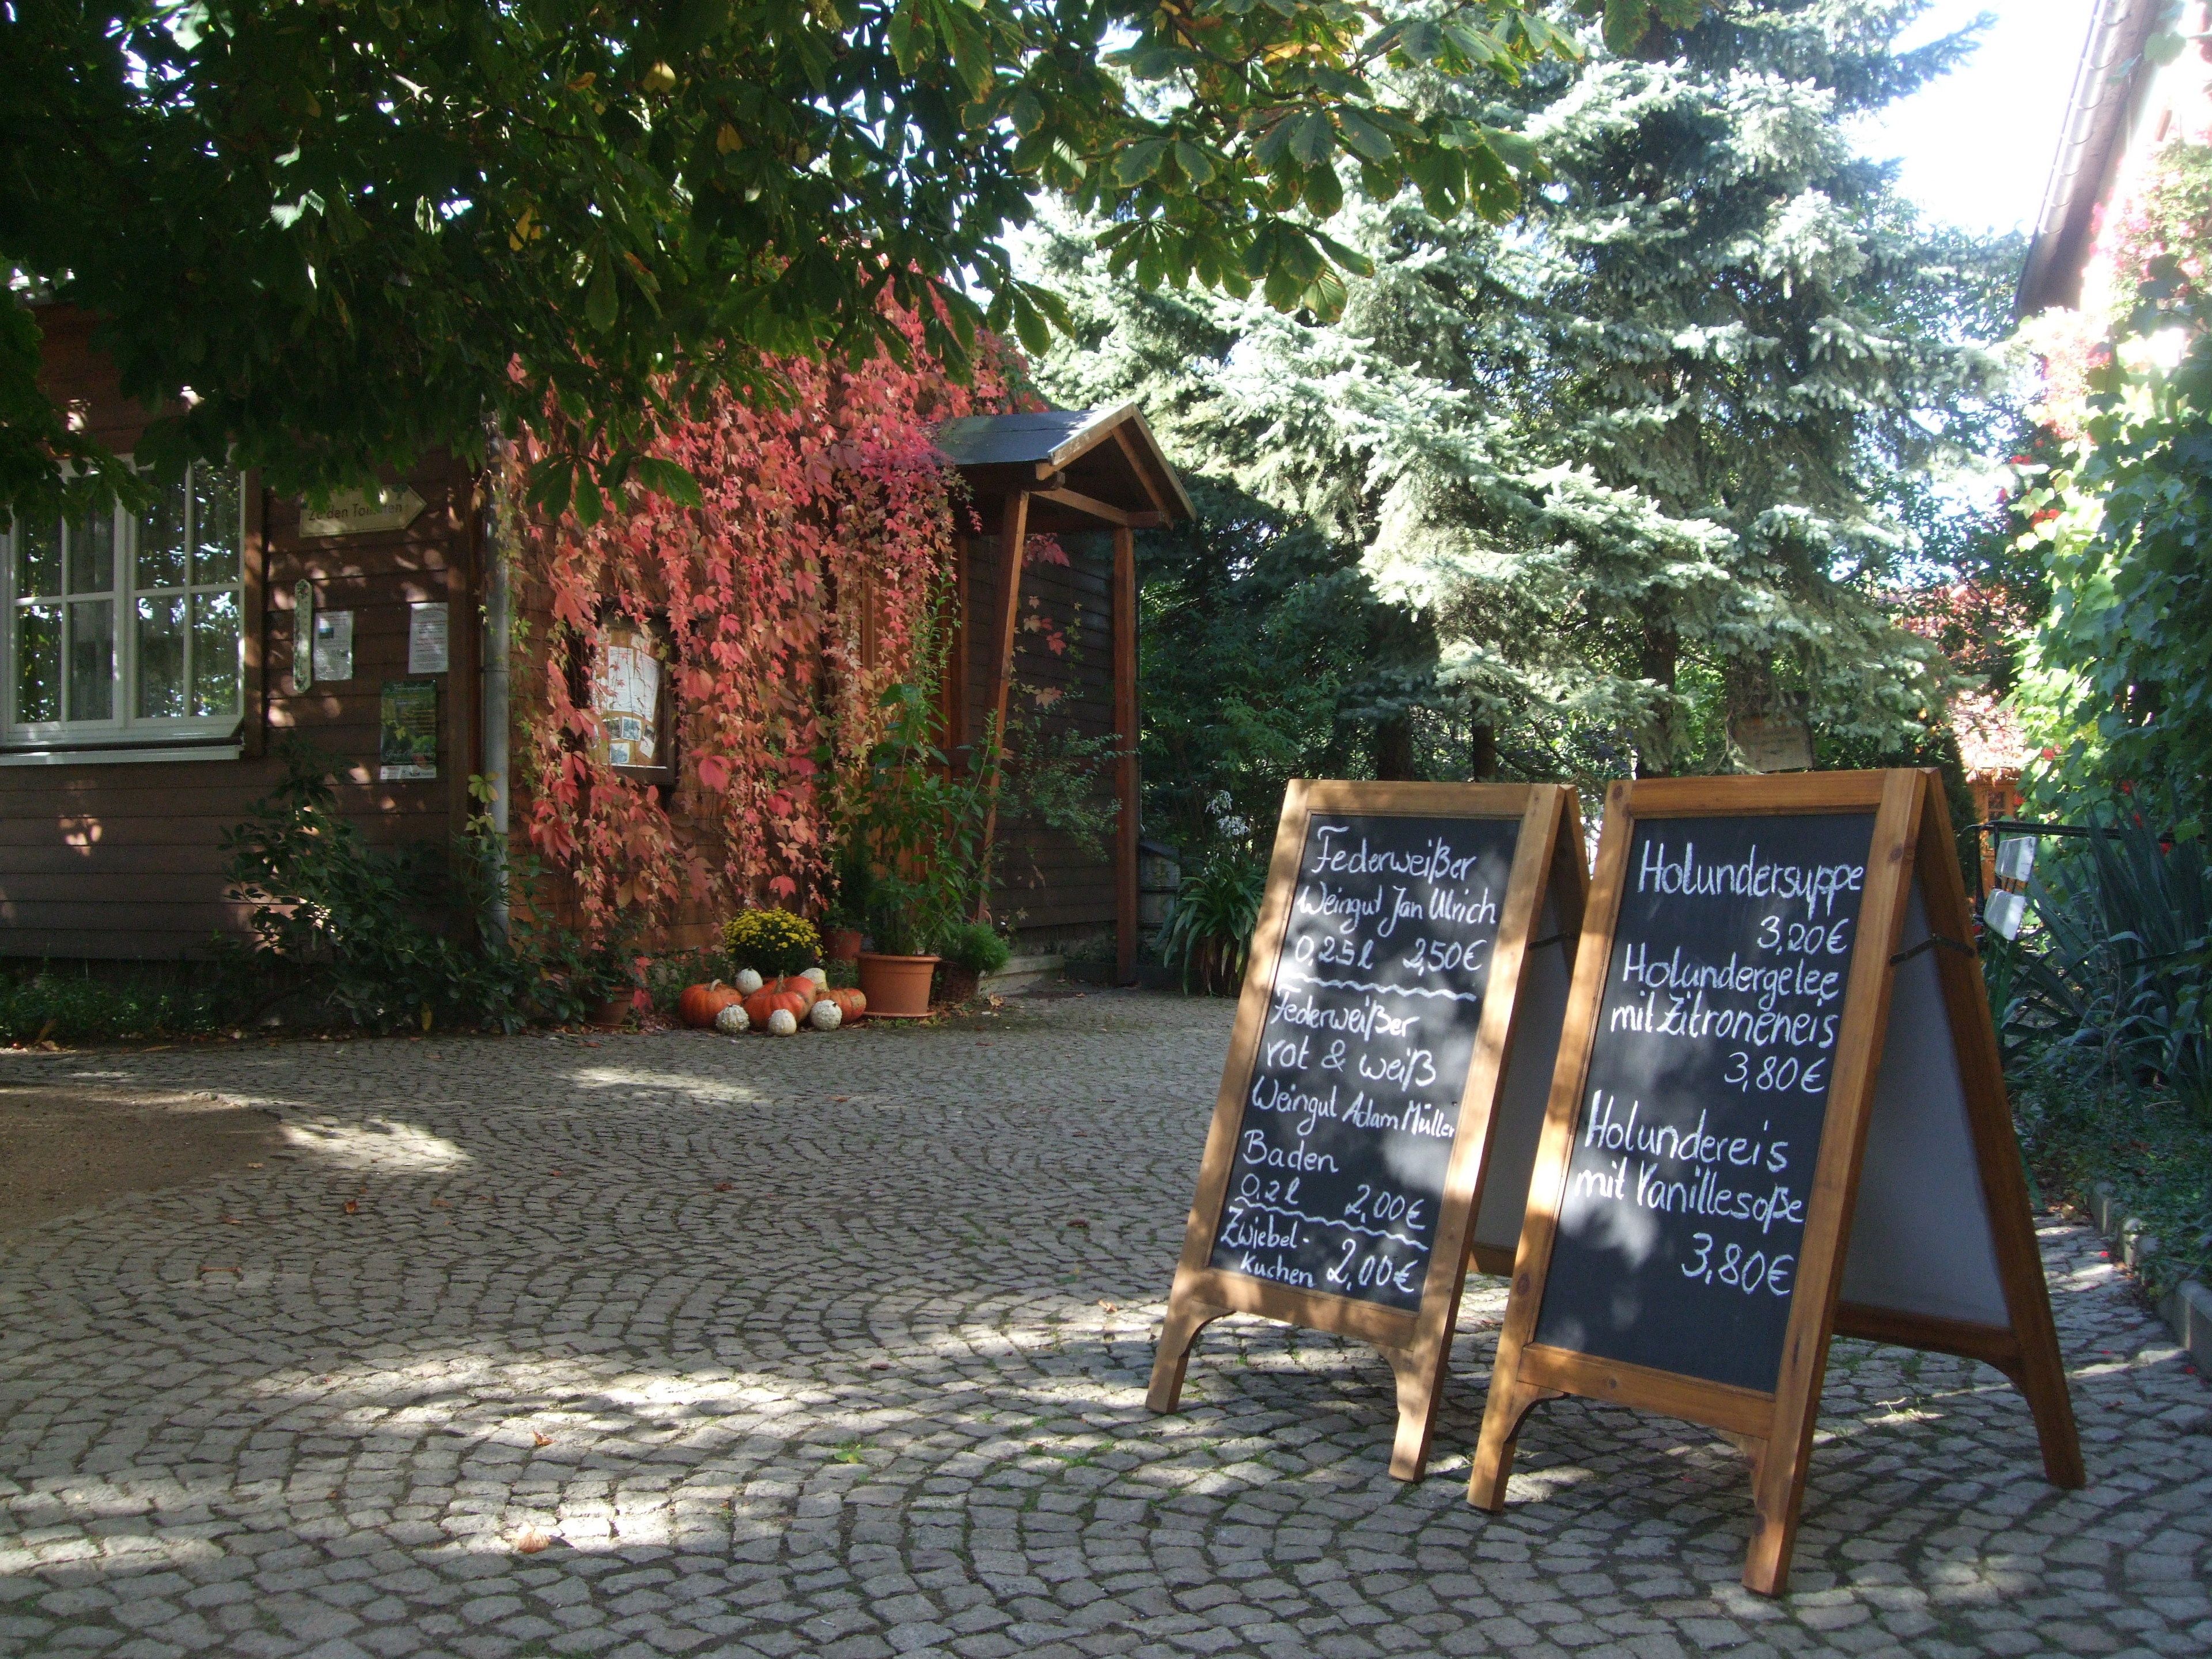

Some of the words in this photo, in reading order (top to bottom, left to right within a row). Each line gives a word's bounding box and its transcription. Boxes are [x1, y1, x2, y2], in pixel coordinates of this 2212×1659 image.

[327, 503, 348, 518] den
[1311, 825, 1477, 883] Federweißer
[1638, 840, 1865, 920] Holundersuppe
[1296, 881, 1381, 934] Weingut
[1377, 885, 1423, 937] Jan
[1429, 888, 1497, 925] Ulrich
[1757, 915, 1849, 955] 3,20€
[1402, 937, 1487, 976] 2,50€
[1623, 942, 1840, 1010] Holundergelee
[1271, 984, 1419, 1041] Federweißer
[1611, 990, 1656, 1033] mit
[1657, 991, 1839, 1049] Zitroneneis
[1266, 1035, 1310, 1070] rot
[1321, 1040, 1344, 1071] &
[1359, 1048, 1436, 1092] weiß
[1725, 1052, 1827, 1093] 3,80€
[1252, 1076, 1337, 1135] Weingut
[1343, 1090, 1398, 1131] Adam
[1402, 1100, 1455, 1138] Müller
[1242, 1129, 1339, 1174] Baden
[1344, 1184, 1426, 1230] 2,00€
[1574, 1157, 1626, 1200] mit
[1637, 1159, 1805, 1234] Vanillesoße
[1326, 1238, 1418, 1293] 2,00€
[1681, 1232, 1794, 1296] 3,80€
